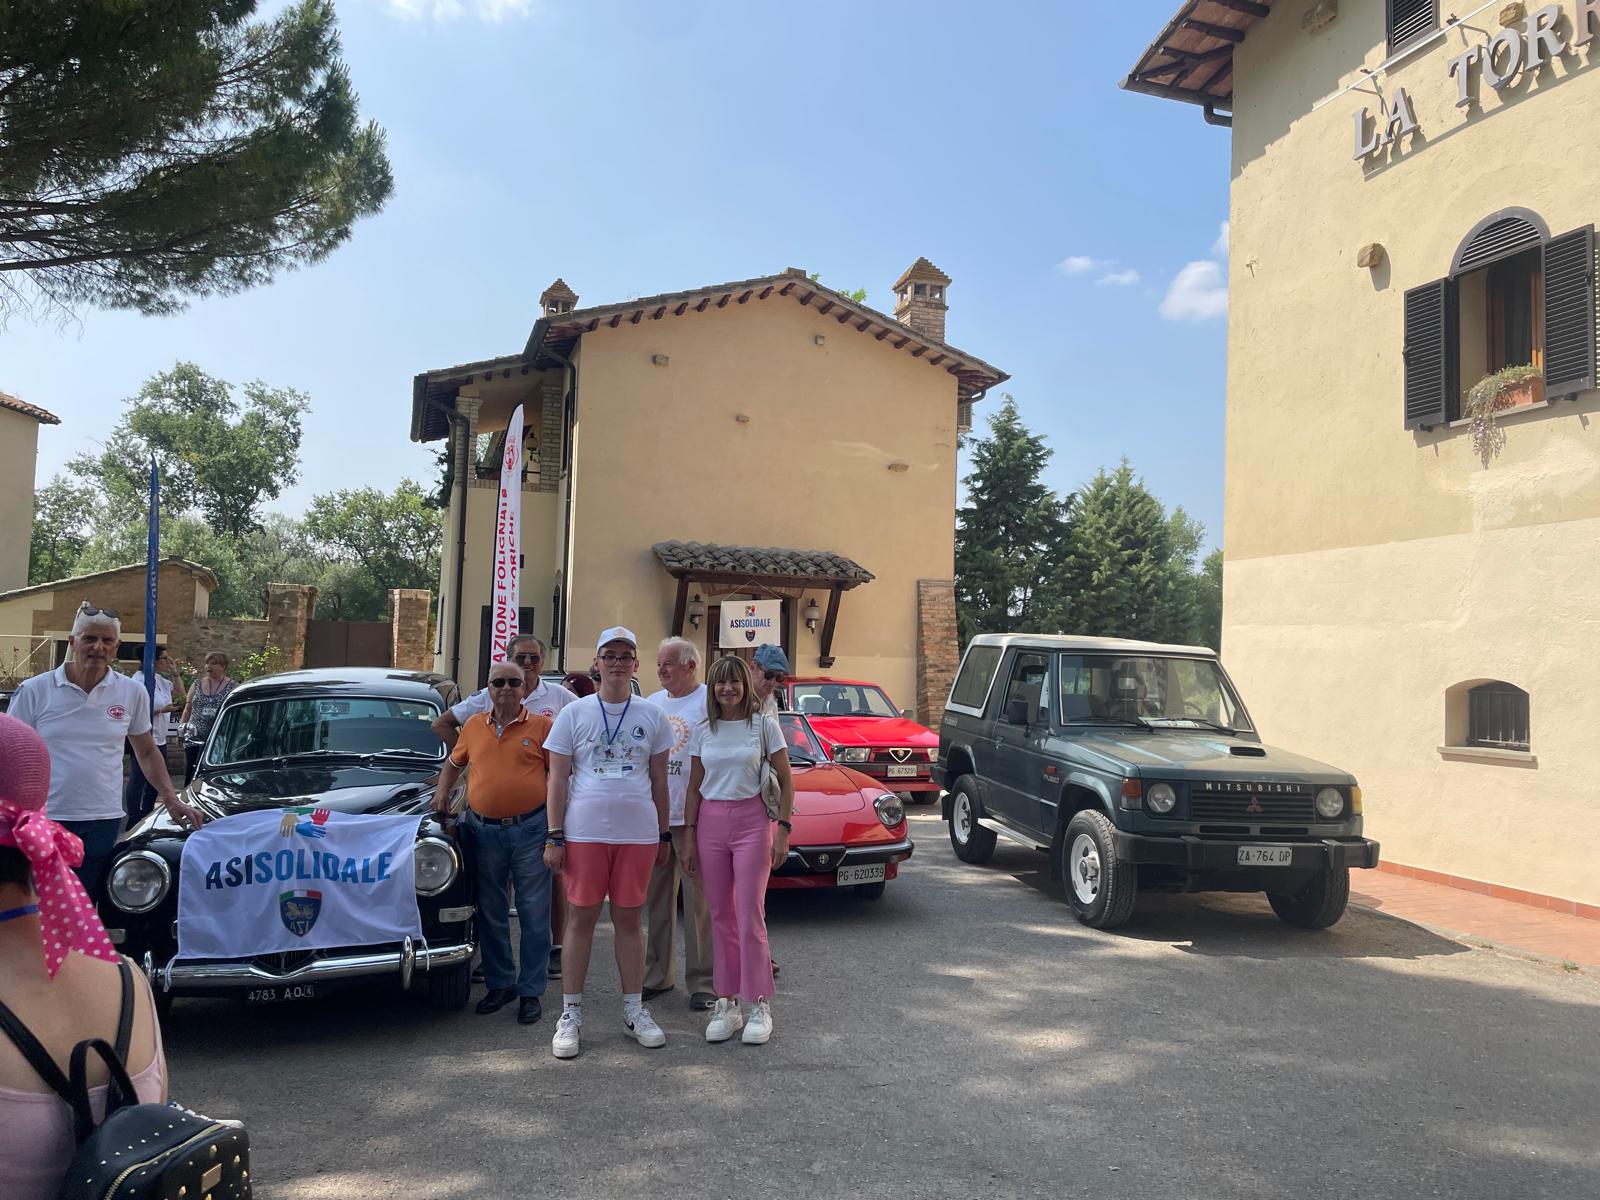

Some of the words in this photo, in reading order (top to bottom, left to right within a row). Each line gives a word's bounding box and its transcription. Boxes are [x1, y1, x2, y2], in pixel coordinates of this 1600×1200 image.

[1352, 87, 1418, 160] LA
[730, 618, 771, 628] ASISOLIDALE
[1205, 782, 1301, 793] MITSUBISHI
[205, 848, 393, 890] ASISOLIDALE
[248, 988, 276, 1001] 4783
